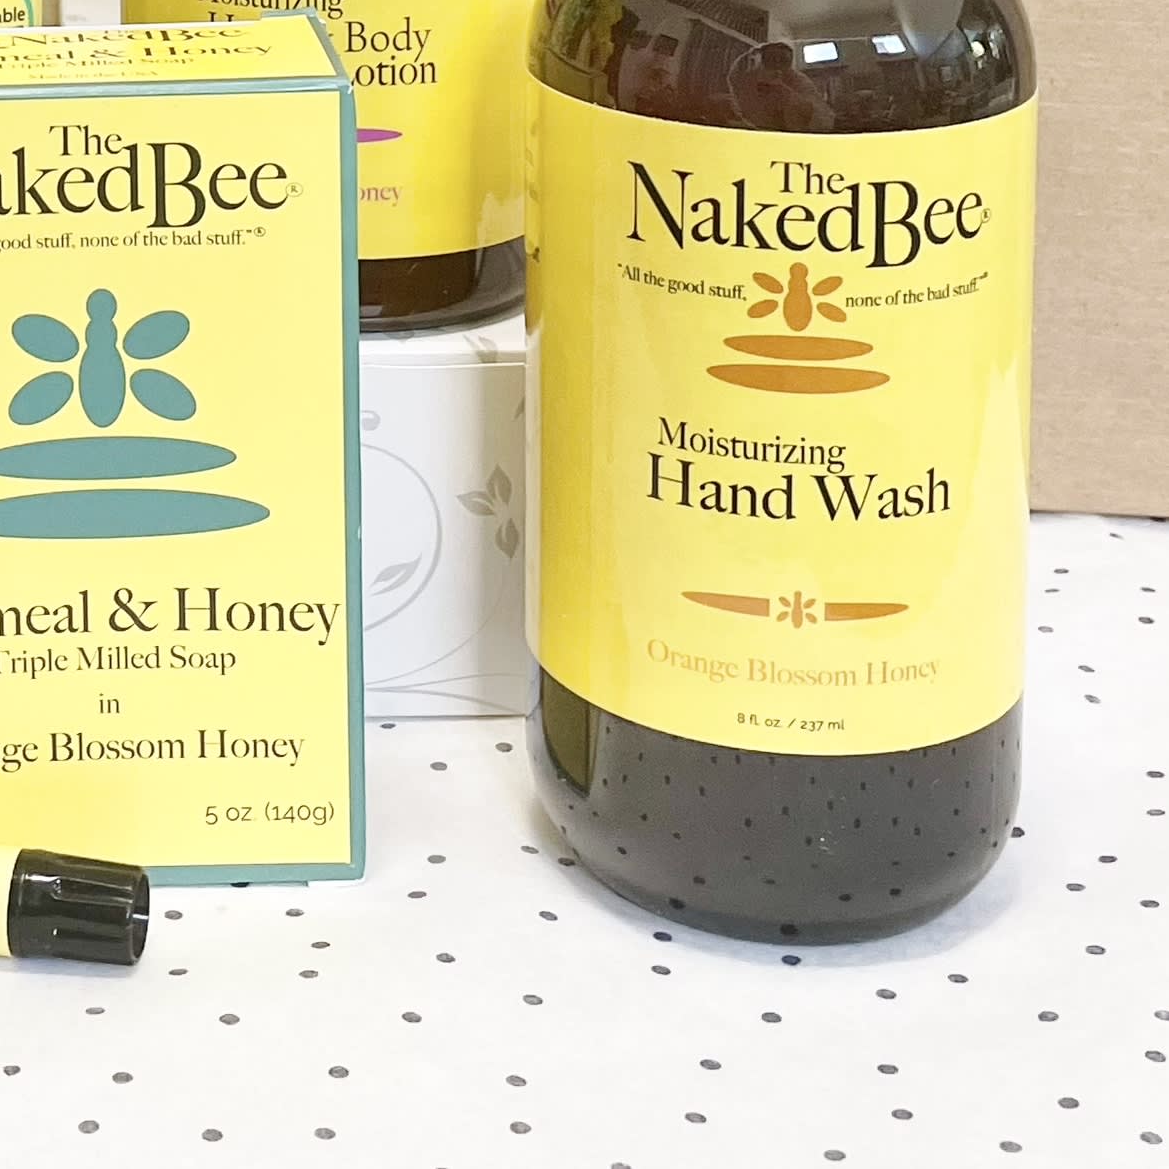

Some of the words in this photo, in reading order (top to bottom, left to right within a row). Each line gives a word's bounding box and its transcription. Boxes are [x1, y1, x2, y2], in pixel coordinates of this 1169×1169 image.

[344, 16, 433, 63] Body
[351, 55, 437, 87] otion
[49, 125, 123, 157] The
[770, 159, 846, 195] The
[80, 236, 119, 248] none
[123, 231, 142, 247] of
[142, 232, 168, 247] the
[171, 231, 201, 246] bad
[644, 272, 665, 288] the
[668, 275, 705, 295] good
[845, 294, 882, 308] none
[886, 289, 902, 307] of
[903, 288, 925, 304] the
[928, 283, 950, 301] bad
[658, 416, 846, 473] Moisturizing
[646, 452, 797, 521] Hand
[814, 467, 951, 522] Wash
[108, 587, 158, 633] &
[174, 587, 342, 646] Honey
[77, 646, 161, 672] Milled
[169, 645, 237, 676] Soap
[647, 638, 740, 683] Orange
[747, 658, 857, 687] Blossom
[866, 658, 941, 685] Honey
[98, 692, 120, 715] in
[737, 712, 746, 724] 8
[787, 718, 797, 729] /
[800, 720, 824, 732] 237
[828, 719, 845, 731] ml
[49, 732, 185, 762] Blossom
[197, 728, 305, 767] Honey
[205, 805, 218, 825] 5
[264, 801, 335, 826] (140g)
